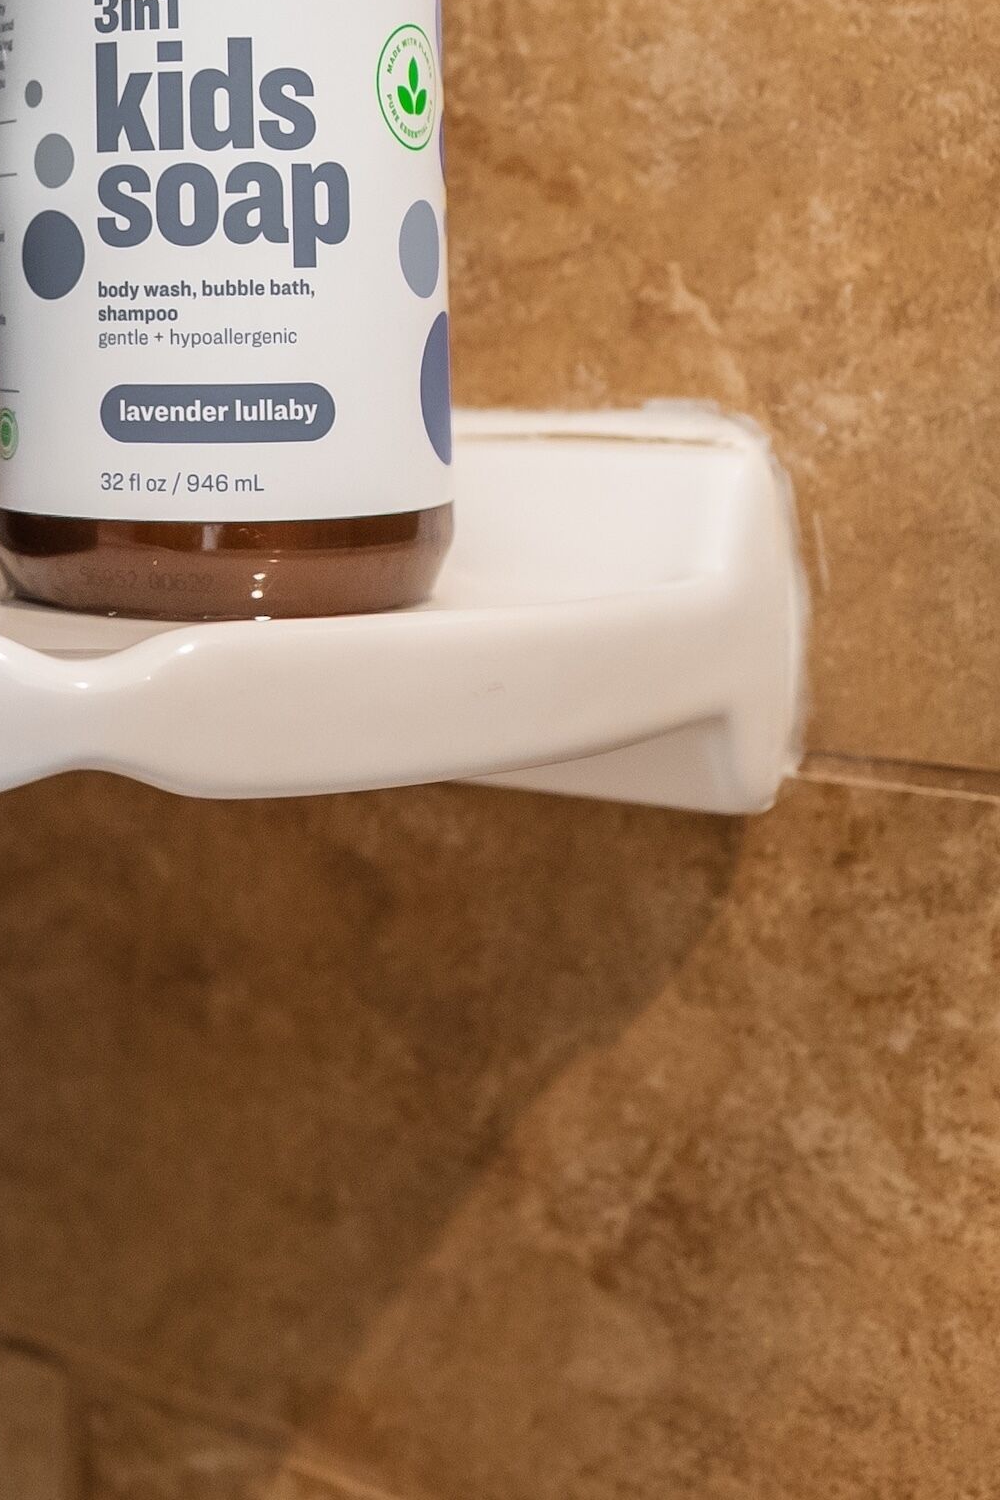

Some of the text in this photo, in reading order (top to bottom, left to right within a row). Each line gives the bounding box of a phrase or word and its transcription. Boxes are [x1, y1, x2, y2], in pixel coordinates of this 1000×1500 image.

[387, 44, 401, 75] MADE
[95, 37, 317, 153] kids
[97, 161, 350, 268] soap
[98, 279, 316, 300] body wash, bubble bath,
[98, 305, 178, 324] shampoo
[98, 328, 149, 349] gentle
[170, 328, 297, 348] hypoallergenic
[119, 398, 318, 424] lavender lullaby
[100, 472, 264, 495] 32 fl oz / 946 mL
